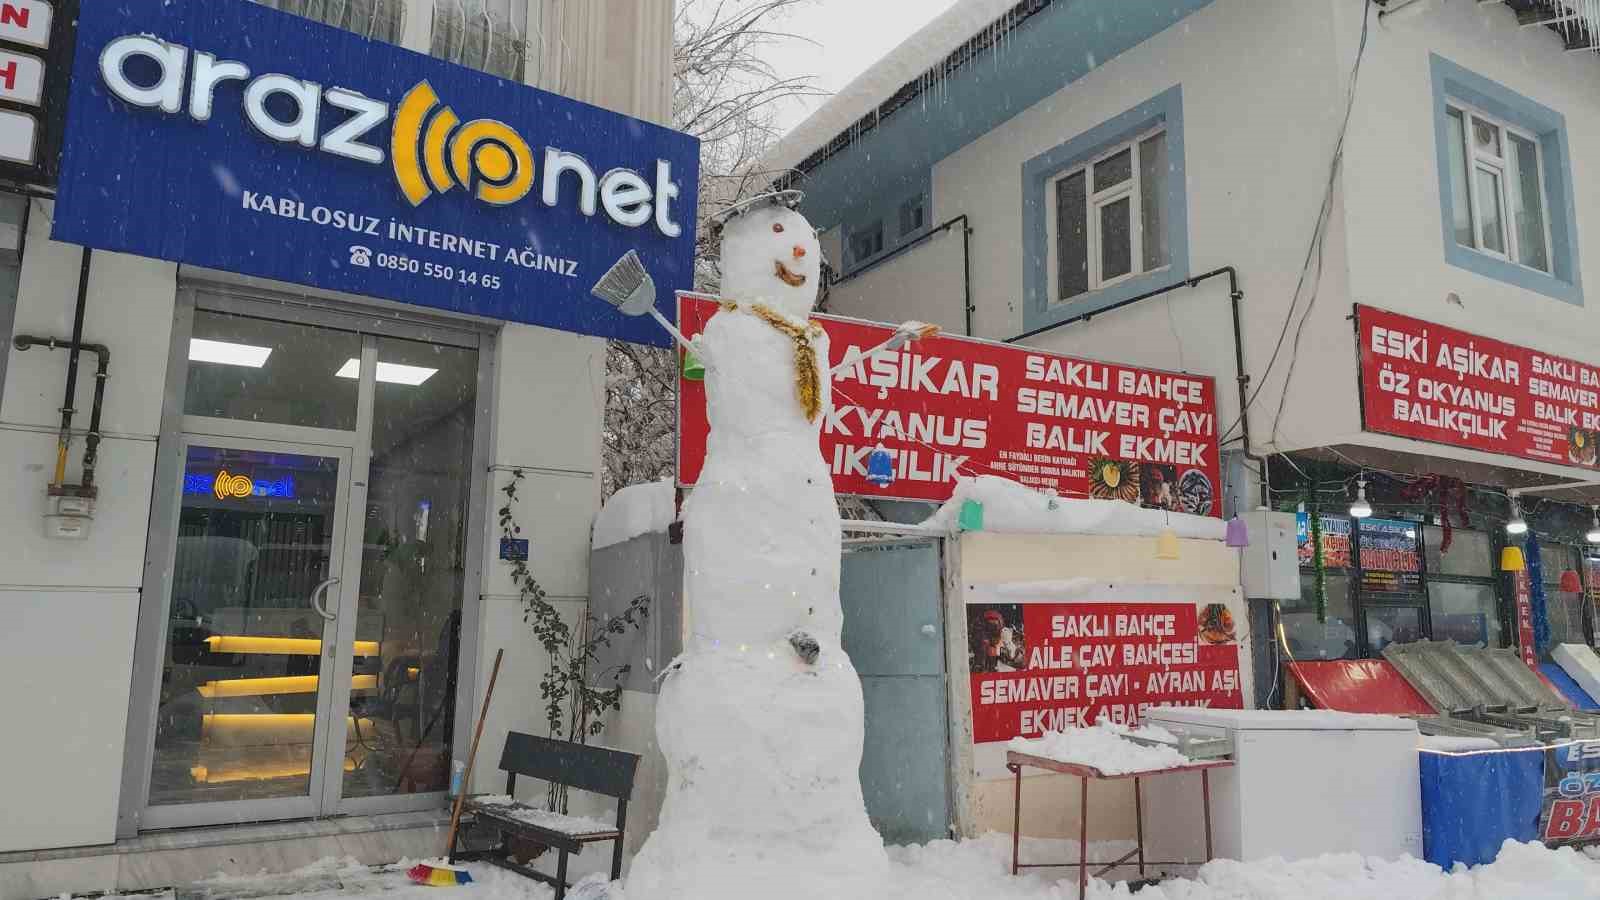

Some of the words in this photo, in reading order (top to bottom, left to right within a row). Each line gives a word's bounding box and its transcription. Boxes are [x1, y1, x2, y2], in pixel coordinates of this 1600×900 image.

[98, 32, 390, 165] araz
[541, 145, 682, 238] net
[242, 190, 380, 236] KABLOSUZ
[388, 216, 501, 262] İNTERNET
[504, 246, 579, 278] AĞINIZ
[376, 252, 420, 275] 0850
[423, 261, 454, 281] 550
[458, 268, 478, 287] 14
[481, 272, 502, 290] 65
[834, 339, 1000, 401] AŞİKAR
[1371, 325, 1428, 364] ESKİ
[1436, 341, 1520, 386] AŞİKAR
[1531, 354, 1576, 382] SAKLI
[1025, 354, 1109, 391] SAKLI
[1118, 370, 1204, 408] BAHÇE
[1379, 362, 1410, 396] ÖZ
[1417, 376, 1517, 417] OKYANUS
[1528, 376, 1599, 409] SEMAVER
[823, 403, 989, 449] KYANUS
[1017, 386, 1150, 428] SEMAVER
[1158, 406, 1214, 439] ÇAYI
[1393, 398, 1508, 441] BALIKÇILIK
[1534, 400, 1579, 427] BALIK
[1026, 422, 1111, 457] BALIK
[1119, 434, 1208, 467] EKMEK
[1052, 614, 1108, 639] SAKLI
[1116, 613, 1176, 642] BAHÇE
[1029, 638, 1073, 671] AİLE
[1079, 643, 1116, 675] ÇAY
[1123, 634, 1199, 671] BAHÇESİ
[980, 675, 1079, 705] SEMAVER
[1085, 673, 1129, 706] ÇAYI
[1146, 669, 1206, 696] AYRAN
[1211, 668, 1240, 698] AŞI
[1020, 706, 1089, 736] EKMEK
